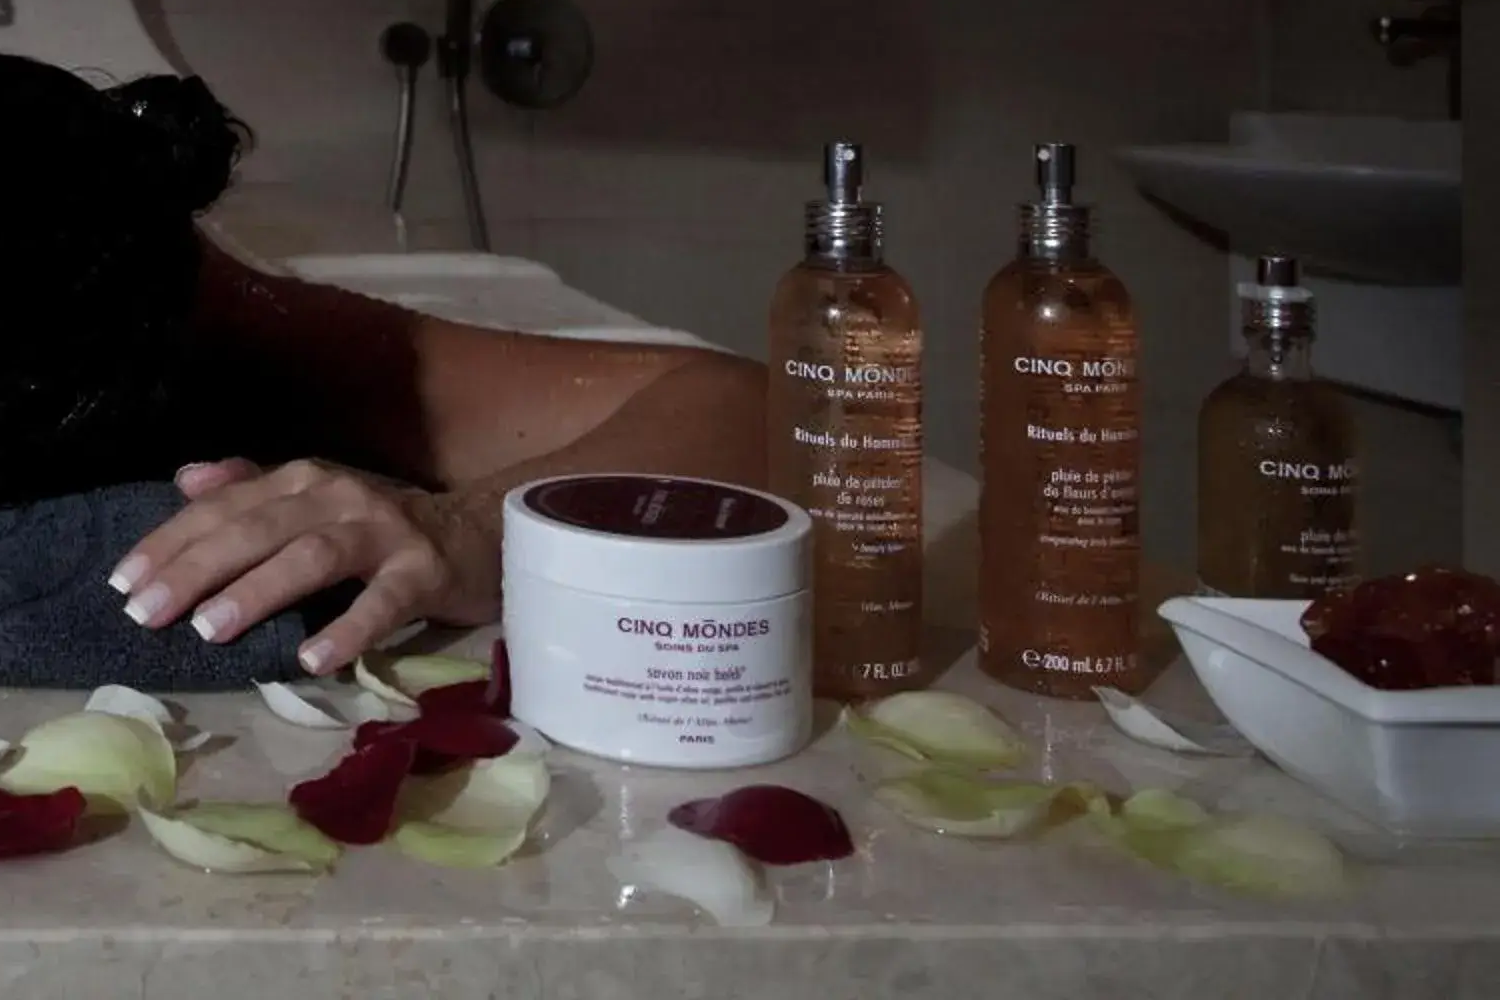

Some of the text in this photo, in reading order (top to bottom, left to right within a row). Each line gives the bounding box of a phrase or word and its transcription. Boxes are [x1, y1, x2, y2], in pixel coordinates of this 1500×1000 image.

[784, 359, 836, 383] CINQ
[1013, 357, 1072, 377] CINQ
[1063, 383, 1091, 393] SPA
[840, 433, 858, 449] du
[1027, 424, 1075, 441] Rituels
[1080, 427, 1097, 443] du
[1259, 460, 1320, 481] CINQ
[617, 617, 673, 639] CINQ
[1043, 653, 1069, 671] 200
